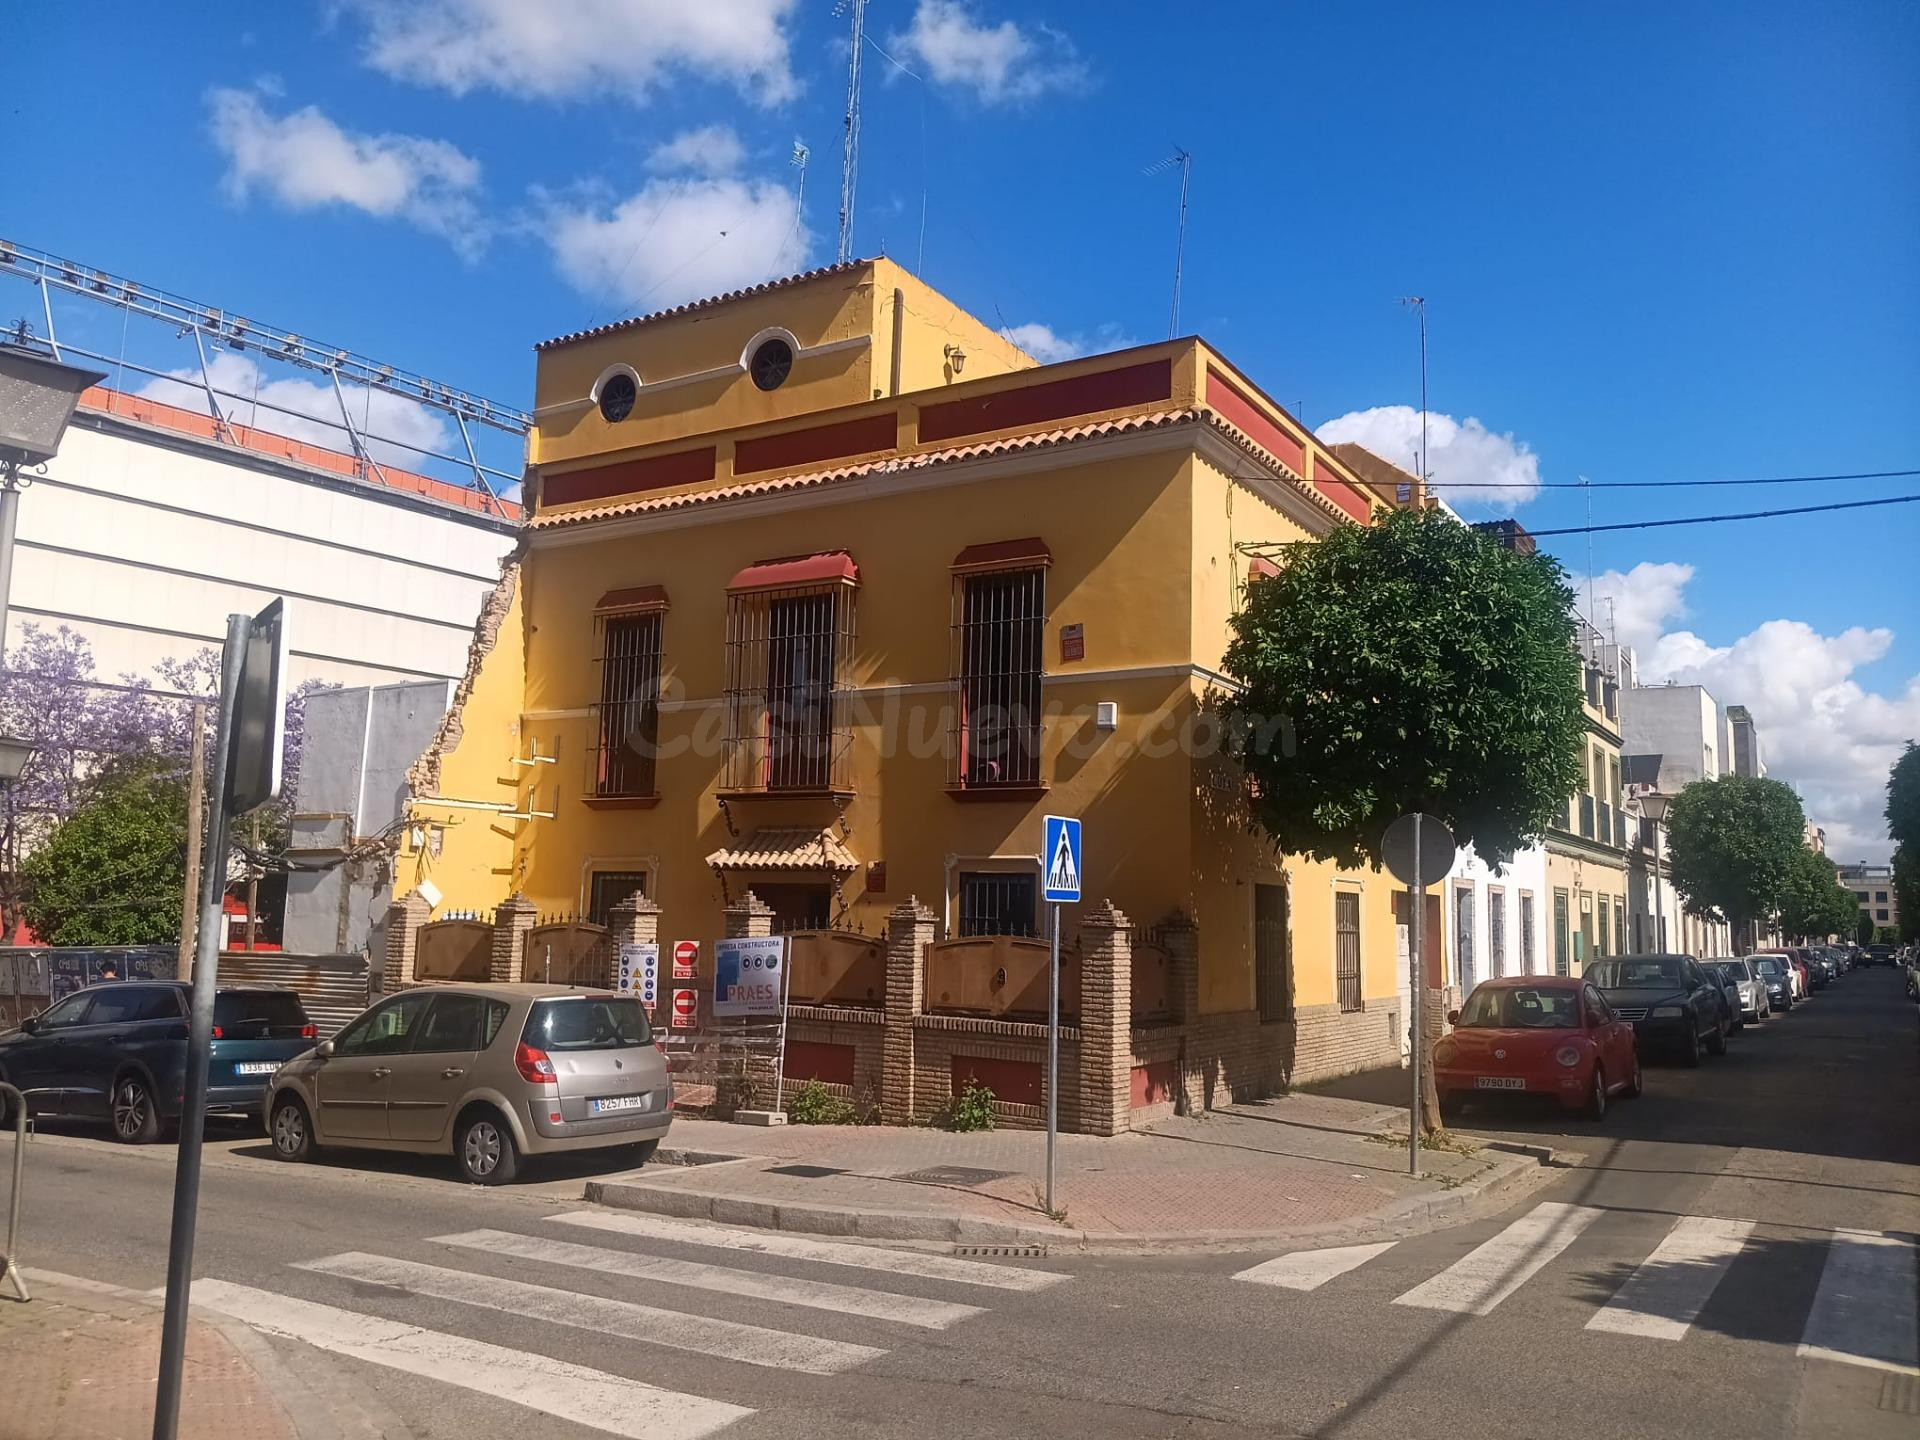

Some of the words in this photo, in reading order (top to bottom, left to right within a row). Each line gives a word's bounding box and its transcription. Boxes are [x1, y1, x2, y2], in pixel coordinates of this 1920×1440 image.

[716, 943, 736, 951] EMPRESA
[738, 940, 779, 949] CONSTRUCTORA
[728, 984, 774, 1000] PRAES
